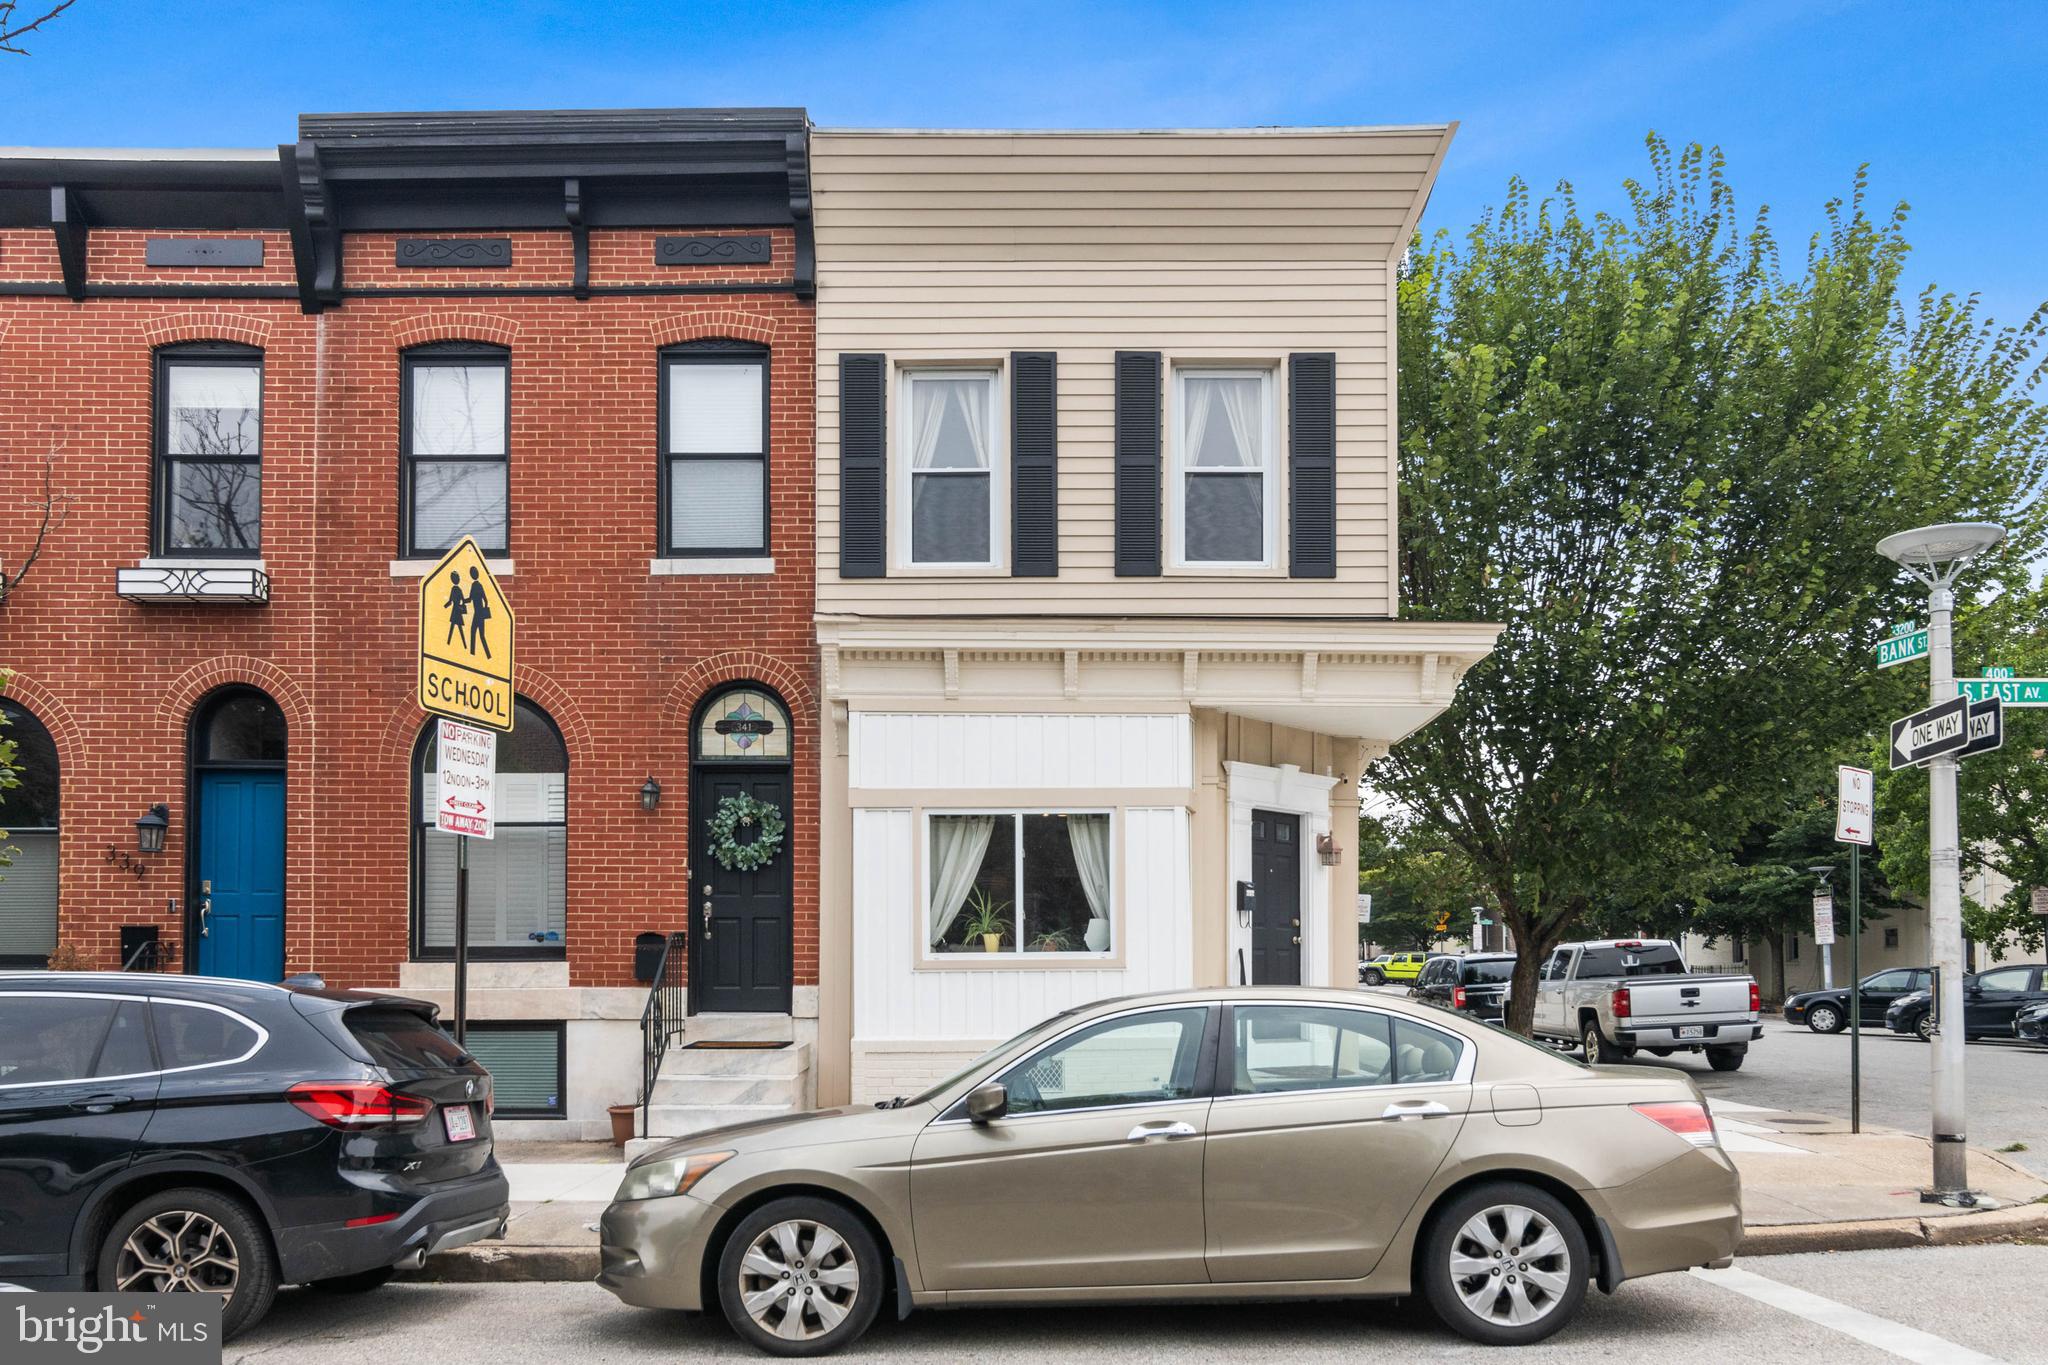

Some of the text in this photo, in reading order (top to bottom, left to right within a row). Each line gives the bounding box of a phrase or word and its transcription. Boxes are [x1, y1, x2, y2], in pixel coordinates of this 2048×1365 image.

[1880, 637, 1915, 663] BANK
[428, 672, 506, 717] SCHOOL
[1963, 683, 2041, 702] S. EAST AV.
[442, 722, 492, 750] NO PARKING
[735, 722, 752, 733] 341
[1912, 713, 1959, 747] ONE WAY
[444, 745, 490, 769] WEDNESDAY
[1852, 777, 1861, 790] NO
[1843, 800, 1869, 817] STOPPING
[440, 813, 454, 828] TOW
[455, 815, 473, 831] AWAY
[105, 844, 146, 881] 339
